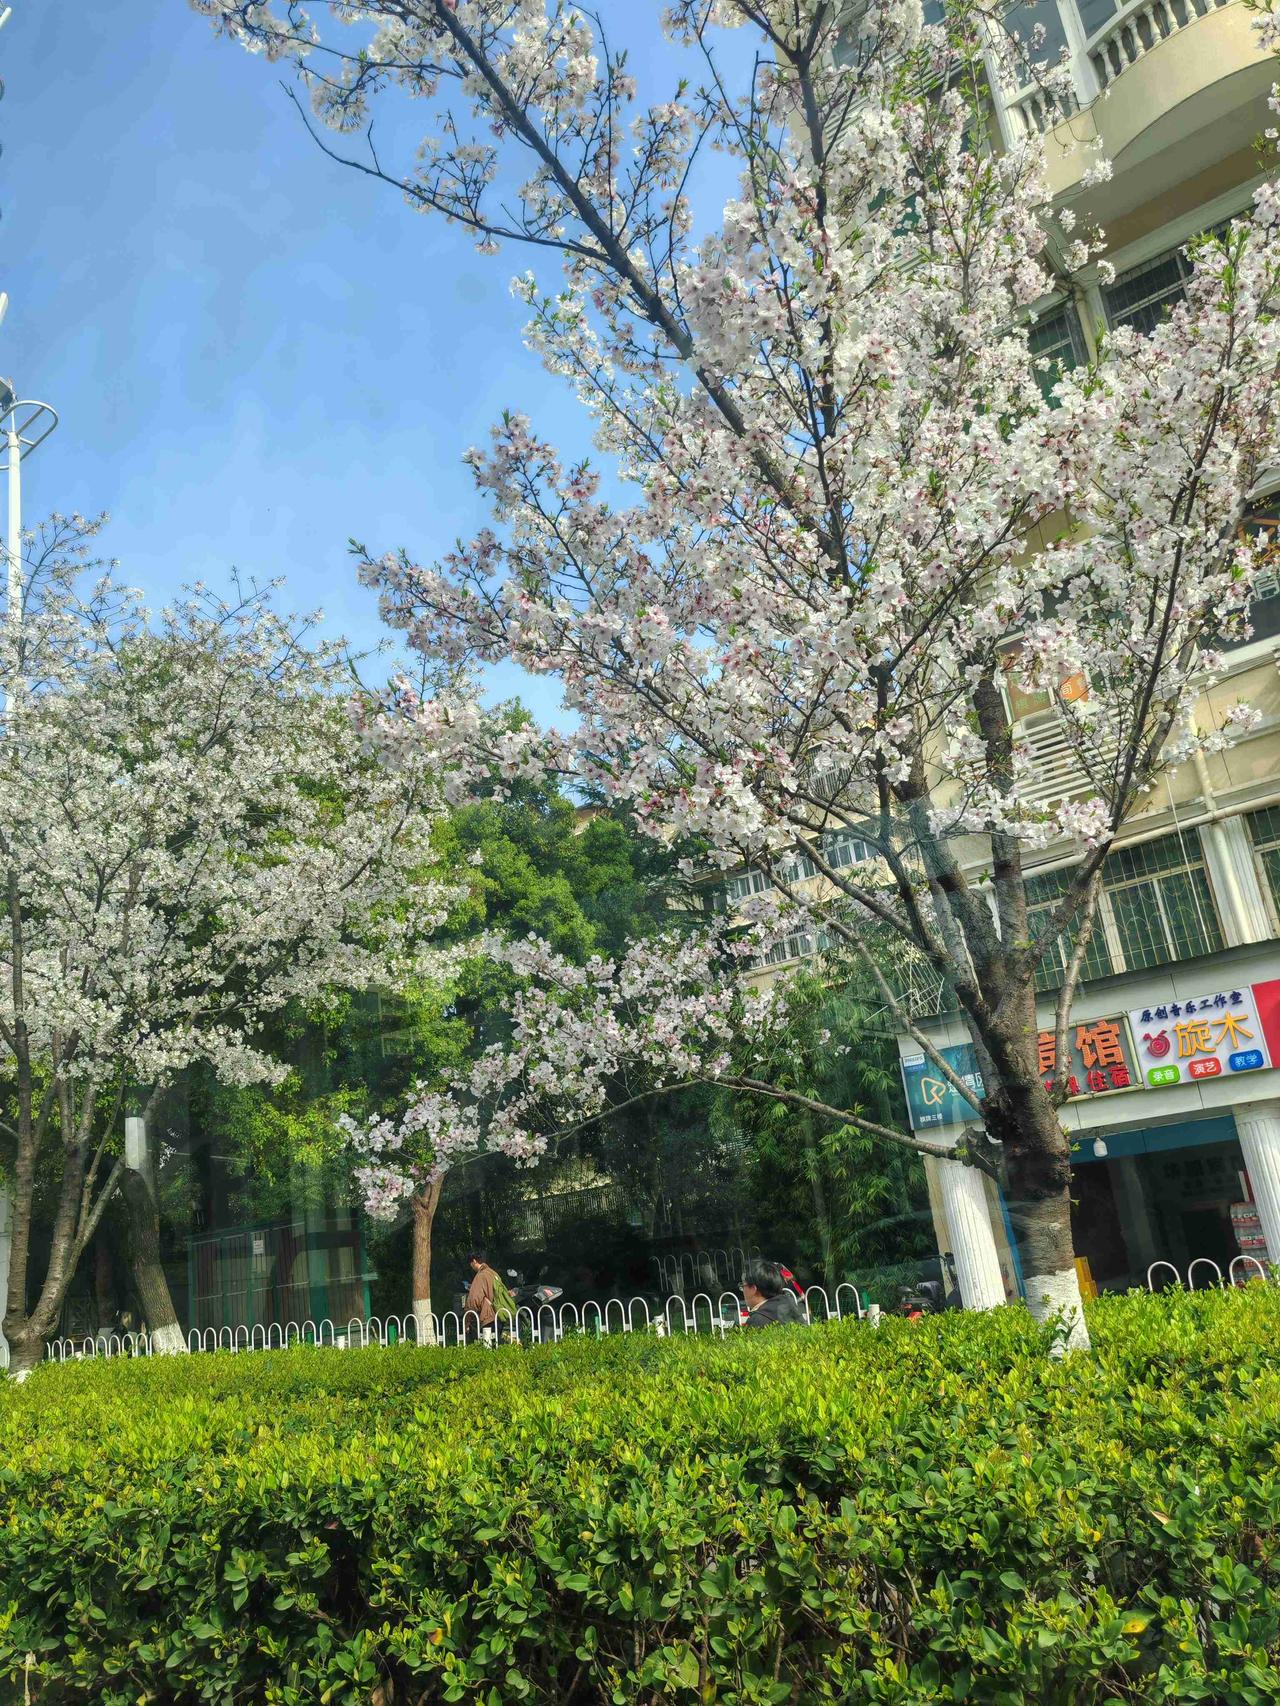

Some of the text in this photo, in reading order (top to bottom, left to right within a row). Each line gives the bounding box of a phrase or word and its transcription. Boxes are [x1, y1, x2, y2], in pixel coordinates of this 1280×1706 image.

[1141, 991, 1243, 1023] 原创音乐工作室
[1173, 1010, 1254, 1059] 旋木
[1193, 1062, 1216, 1075] 演艺
[1235, 1054, 1258, 1066] 教学
[1086, 1065, 1131, 1092] 住宿
[1153, 1070, 1175, 1081] 录音
